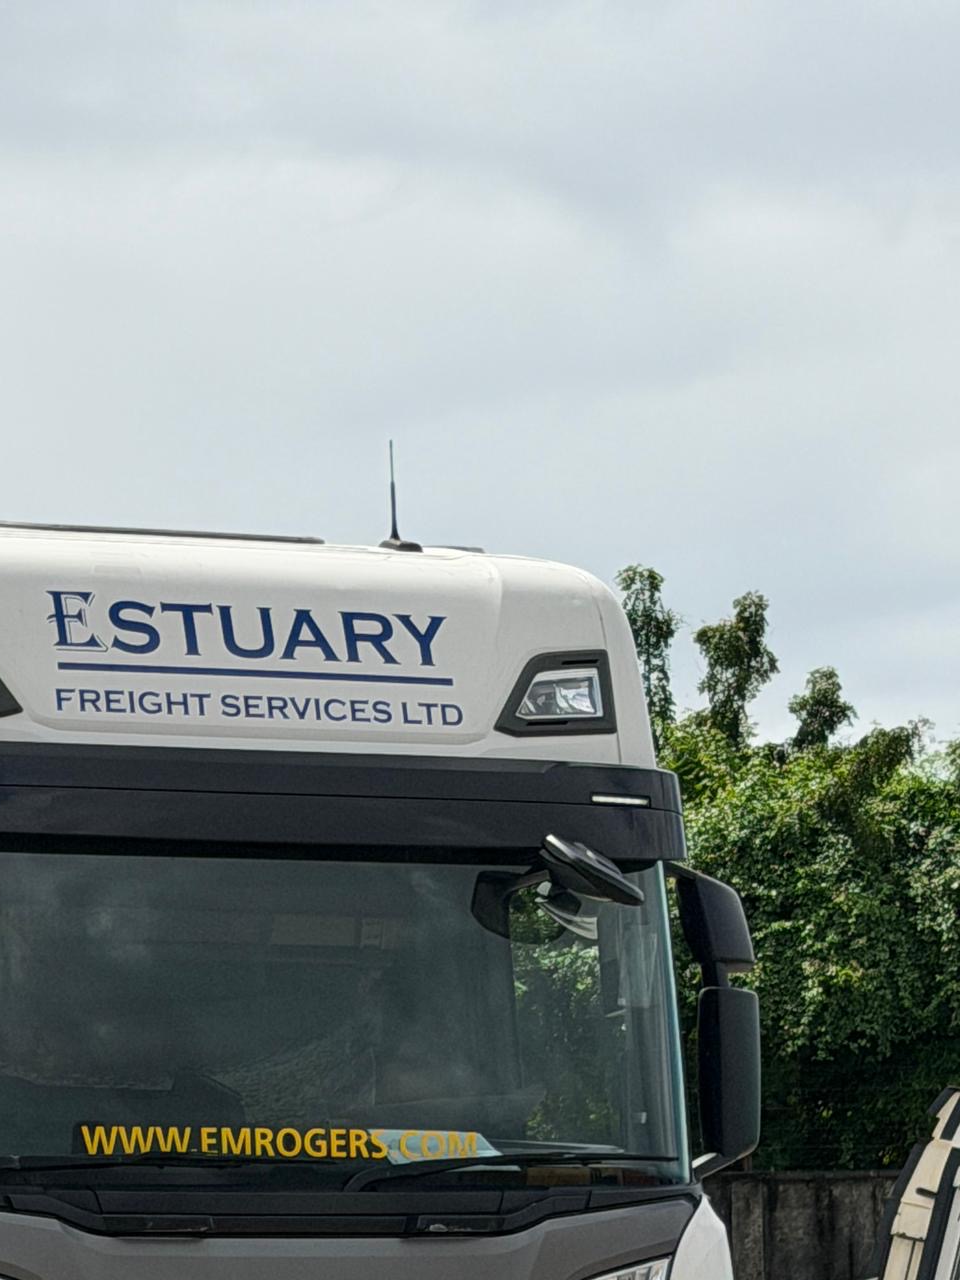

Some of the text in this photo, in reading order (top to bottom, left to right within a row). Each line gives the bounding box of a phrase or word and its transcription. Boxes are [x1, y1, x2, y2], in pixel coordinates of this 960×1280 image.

[46, 590, 447, 667] ESTUARY
[55, 688, 464, 727] FREIGHT SERVICES LTD
